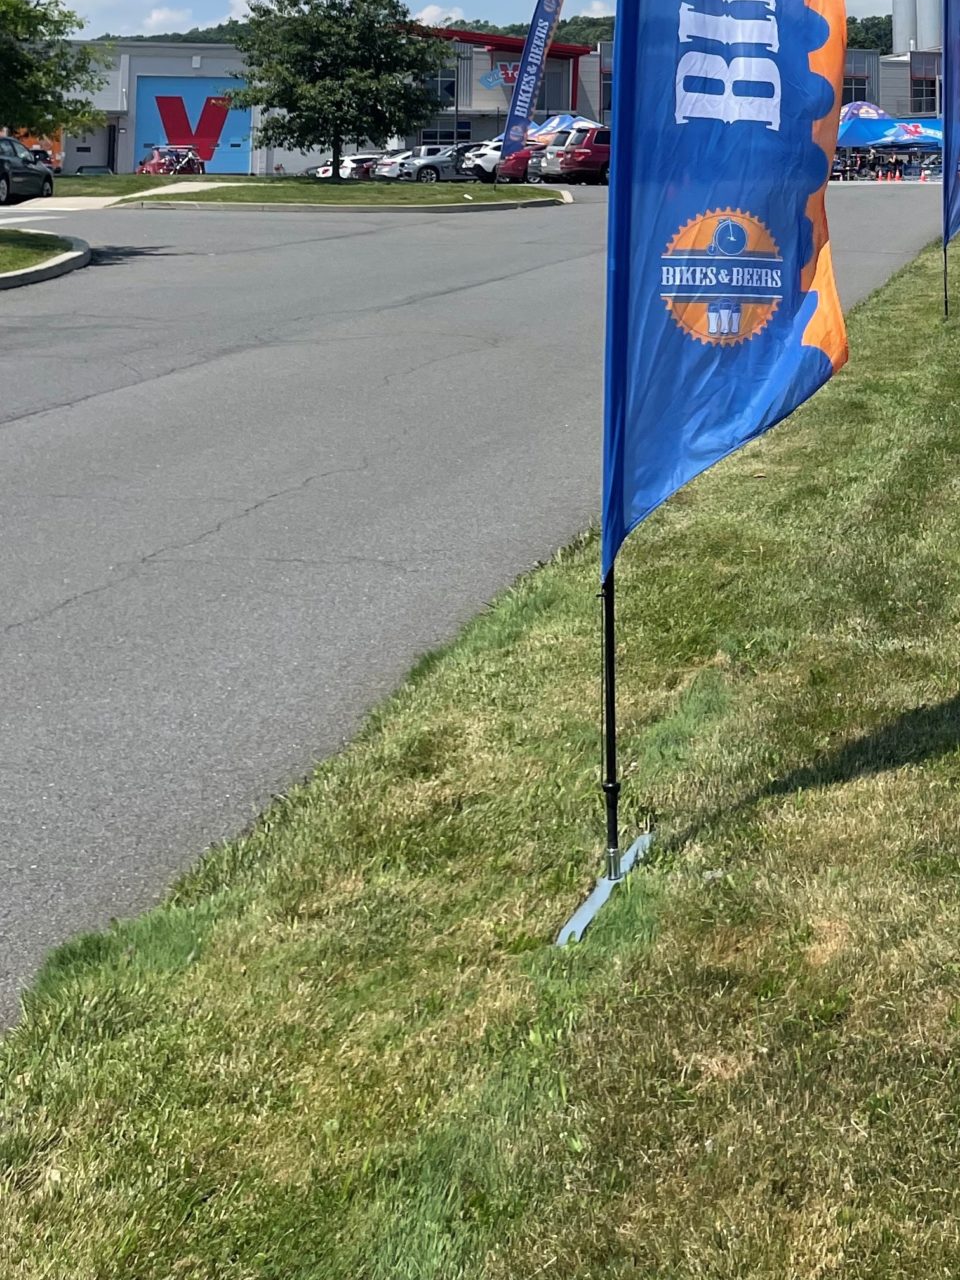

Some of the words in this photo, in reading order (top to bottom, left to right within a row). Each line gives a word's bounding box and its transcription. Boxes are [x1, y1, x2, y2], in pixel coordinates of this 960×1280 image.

[514, 74, 536, 118] BIKES
[528, 19, 550, 65] BEERS
[154, 96, 232, 161] V
[661, 266, 717, 286] BIKES
[731, 267, 782, 288] BEERS
